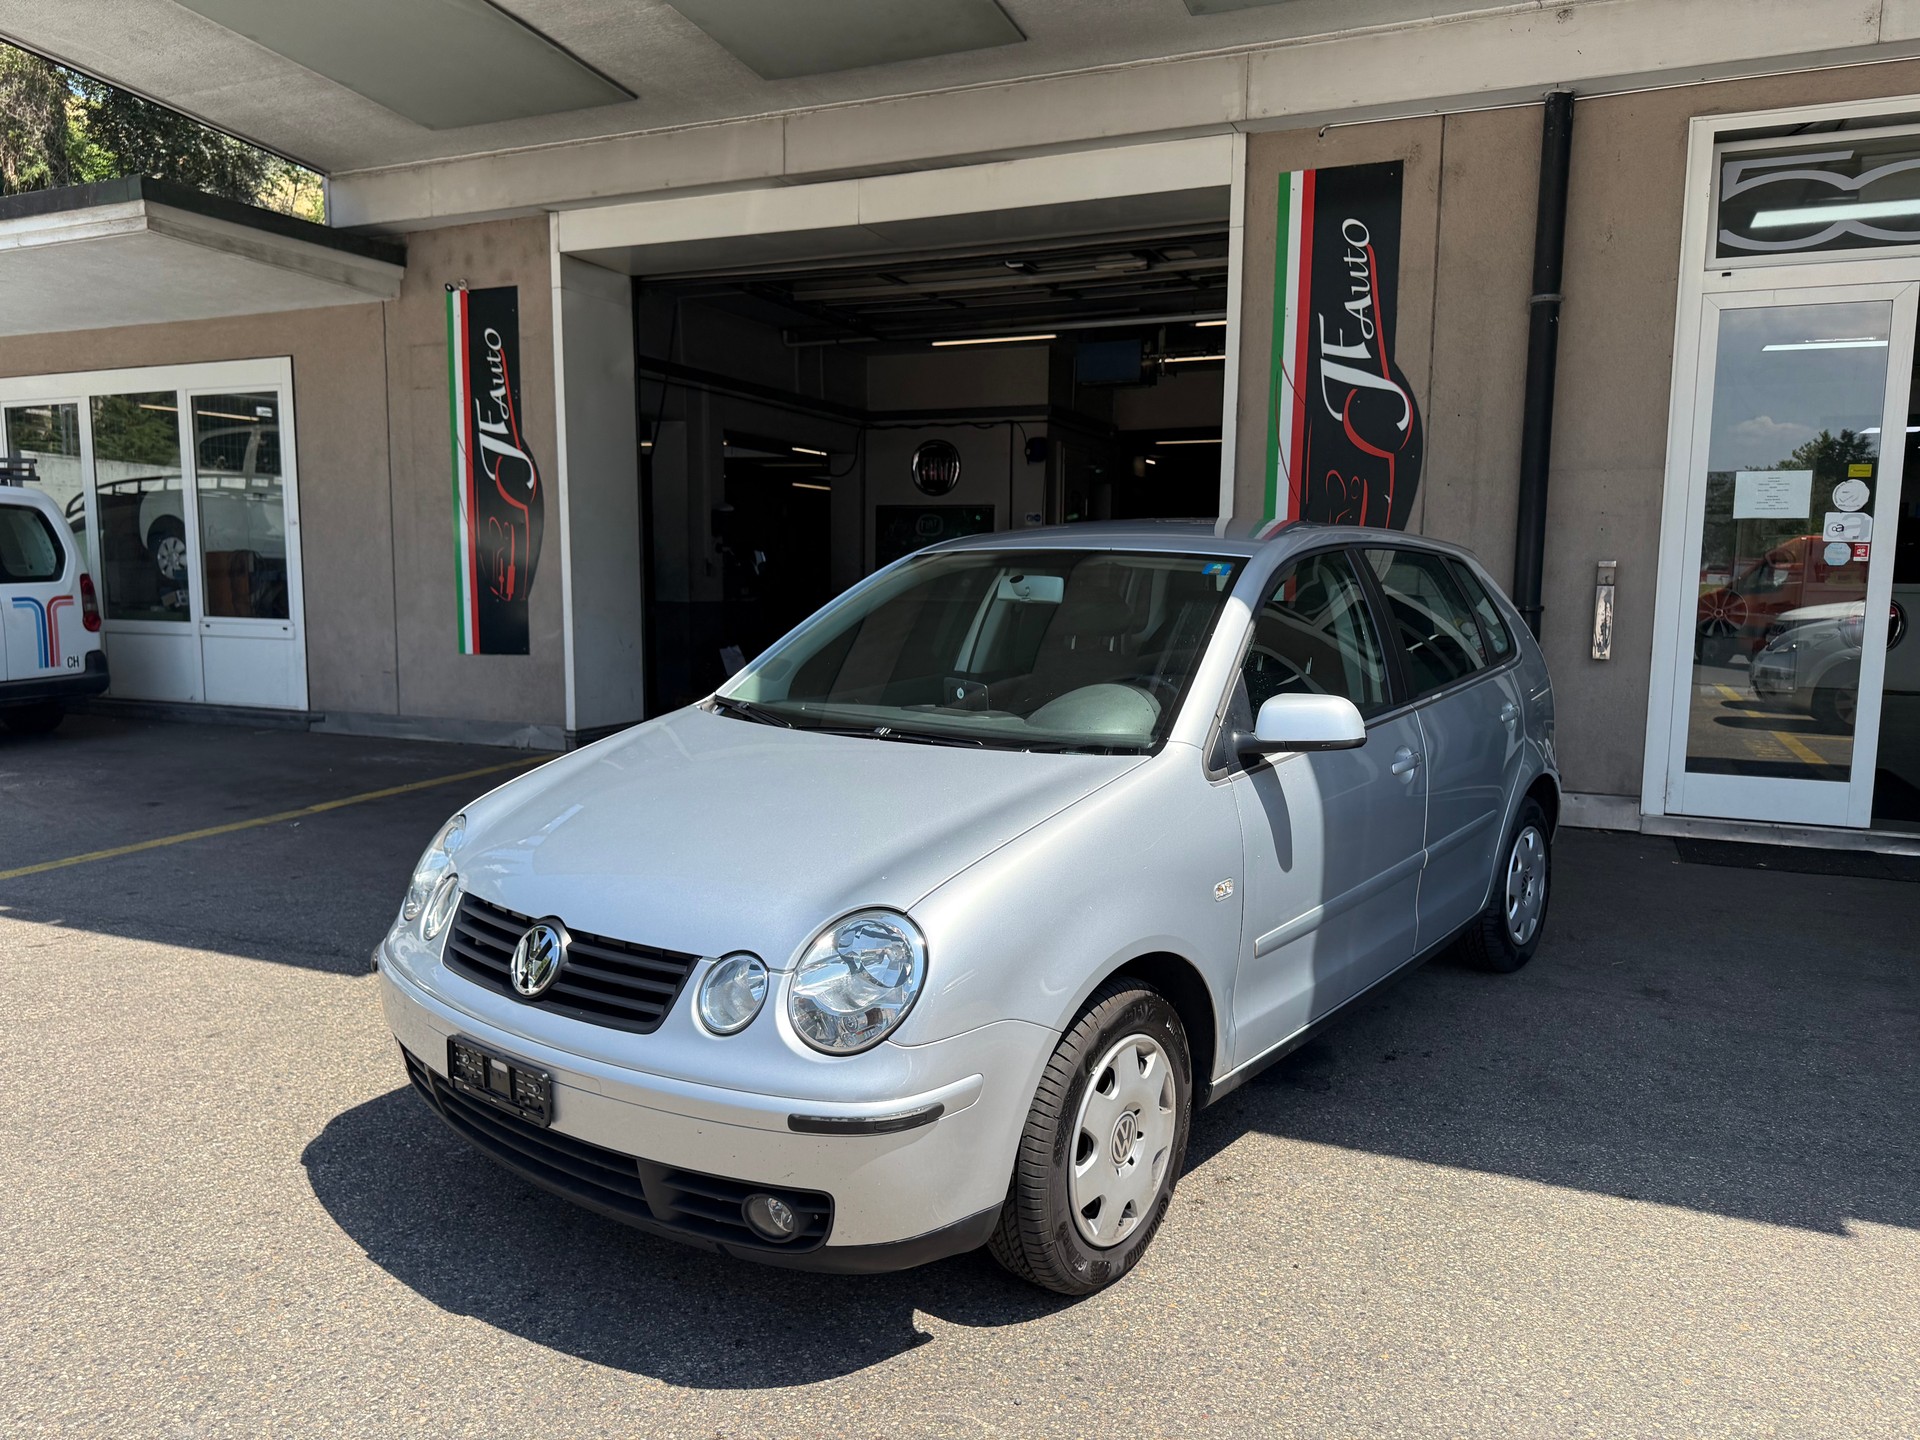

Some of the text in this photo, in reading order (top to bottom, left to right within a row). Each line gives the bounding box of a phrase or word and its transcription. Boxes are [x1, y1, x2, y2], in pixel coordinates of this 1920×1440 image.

[1342, 218, 1376, 339] Auto
[484, 328, 509, 419] Auto
[66, 655, 80, 669] CH
[1111, 1114, 1136, 1164] VW
